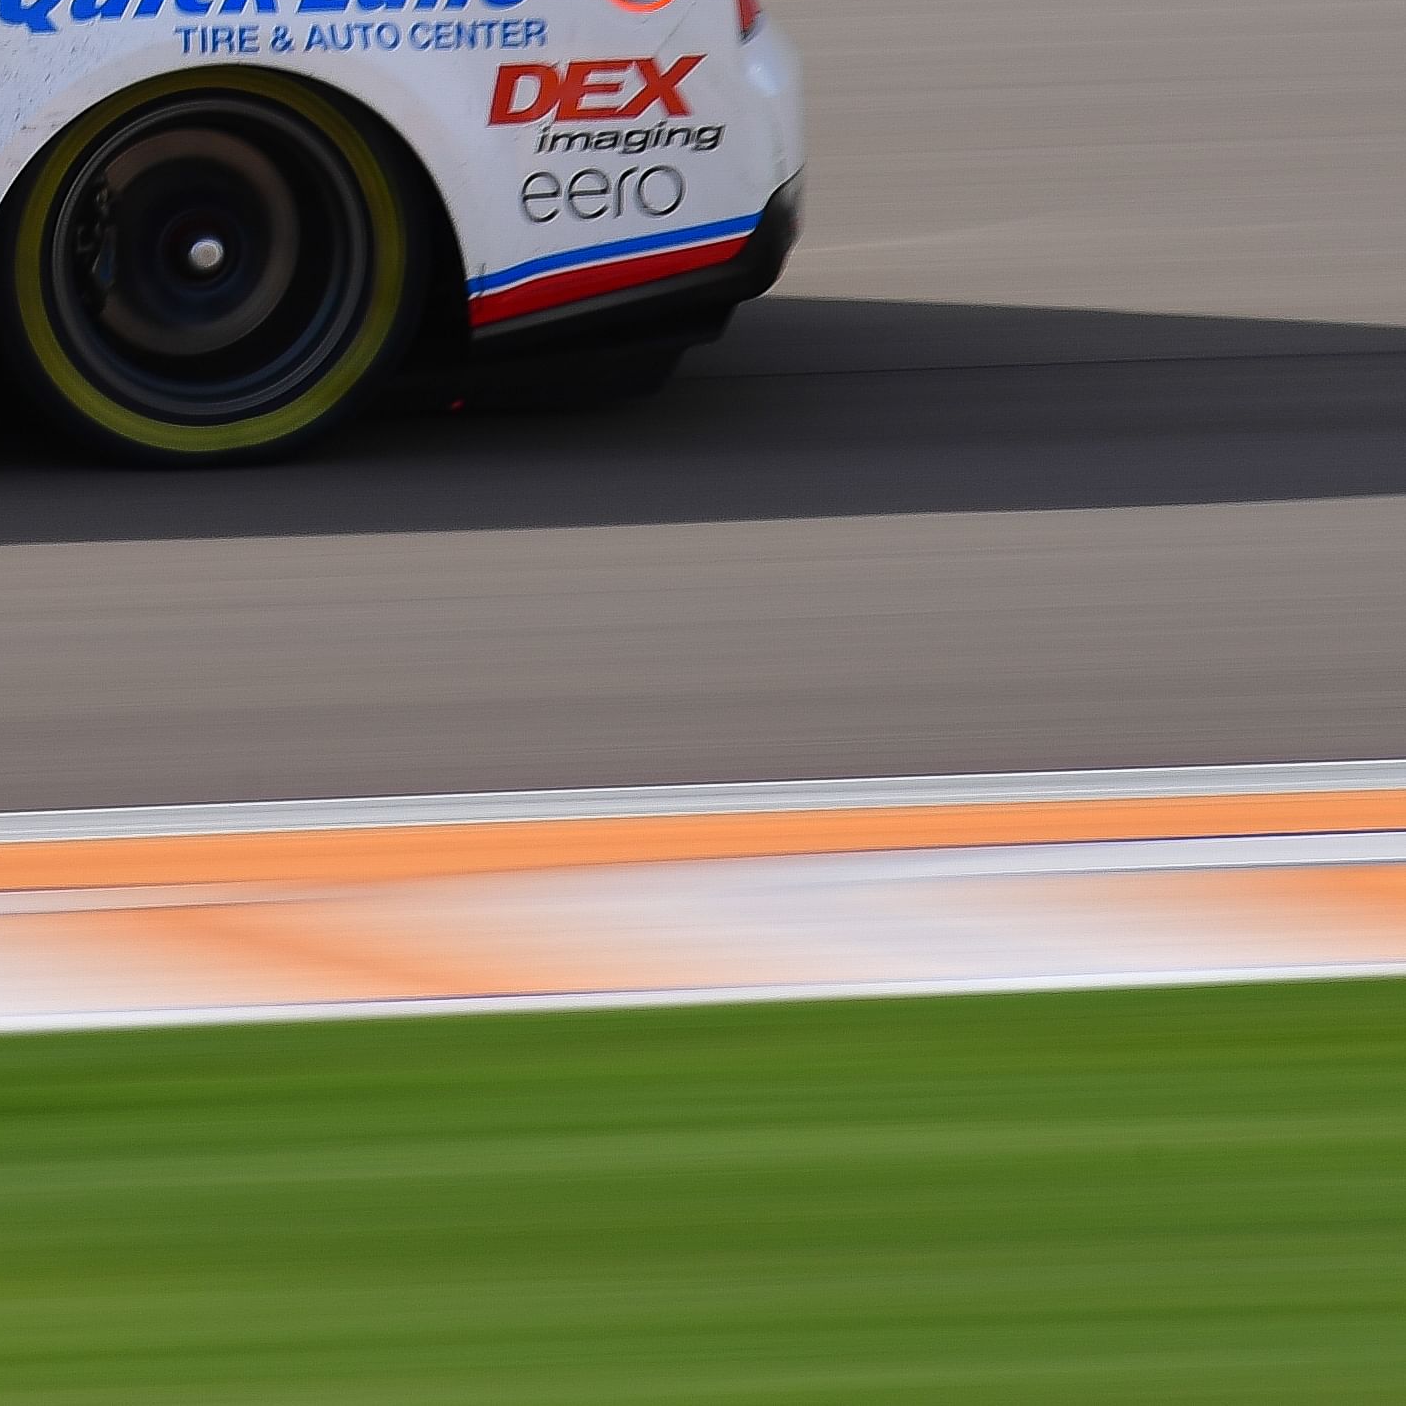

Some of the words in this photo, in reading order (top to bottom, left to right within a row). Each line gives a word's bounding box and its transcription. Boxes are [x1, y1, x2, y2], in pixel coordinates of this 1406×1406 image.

[174, 24, 260, 55] TIRE
[271, 23, 295, 53] &
[303, 21, 400, 53] AUTO
[408, 18, 549, 52] CENTER
[486, 54, 708, 128] DEX
[534, 121, 725, 155] imaging
[520, 163, 687, 224] eero
